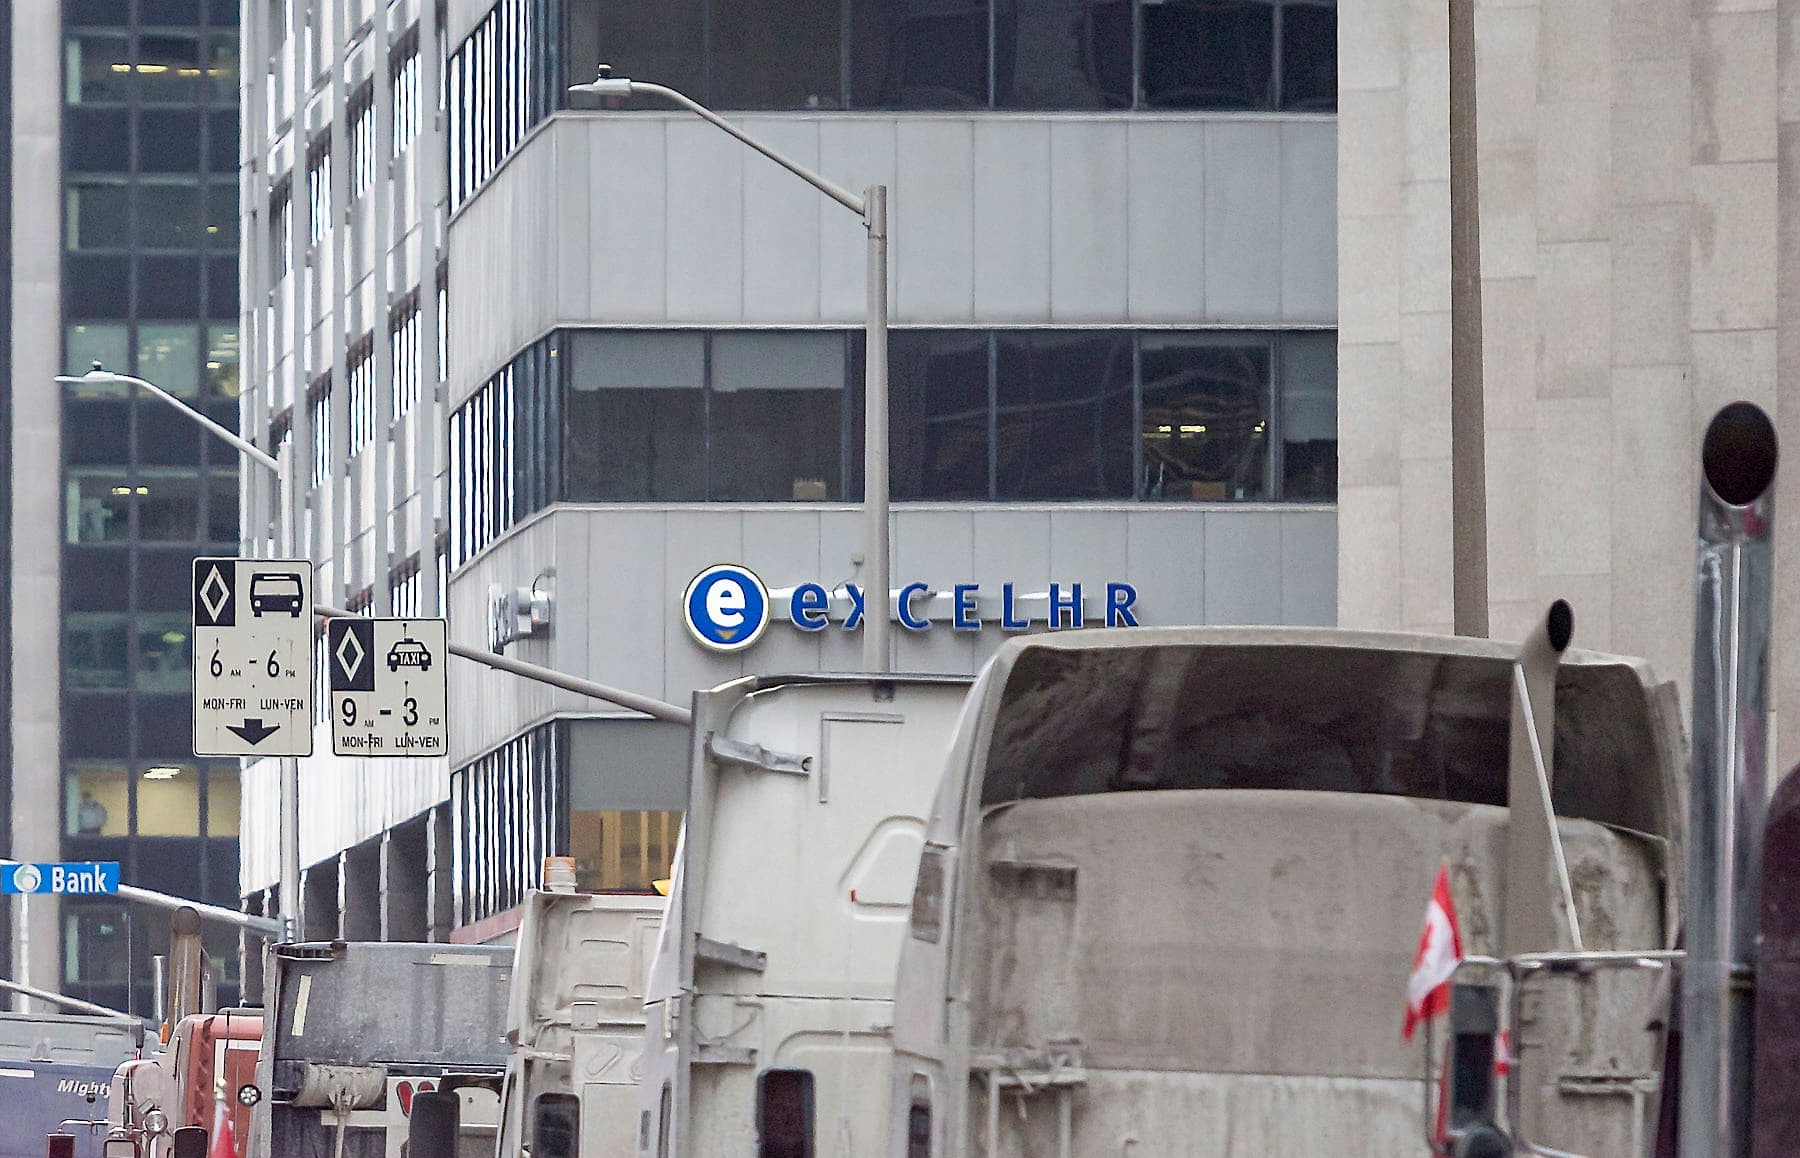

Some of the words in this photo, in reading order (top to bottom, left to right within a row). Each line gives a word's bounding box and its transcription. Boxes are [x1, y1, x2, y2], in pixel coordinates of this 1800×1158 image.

[209, 649, 223, 678] 6
[267, 649, 280, 678] 6
[399, 652, 420, 665] TAXI
[203, 698, 246, 710] MON-FRI
[260, 698, 304, 710] LUN-VEN
[341, 697, 357, 727] 9
[402, 697, 419, 727] 3
[342, 736, 384, 748] MON-FRI
[395, 736, 440, 748] LUN-VEN
[51, 867, 107, 894] Bank
